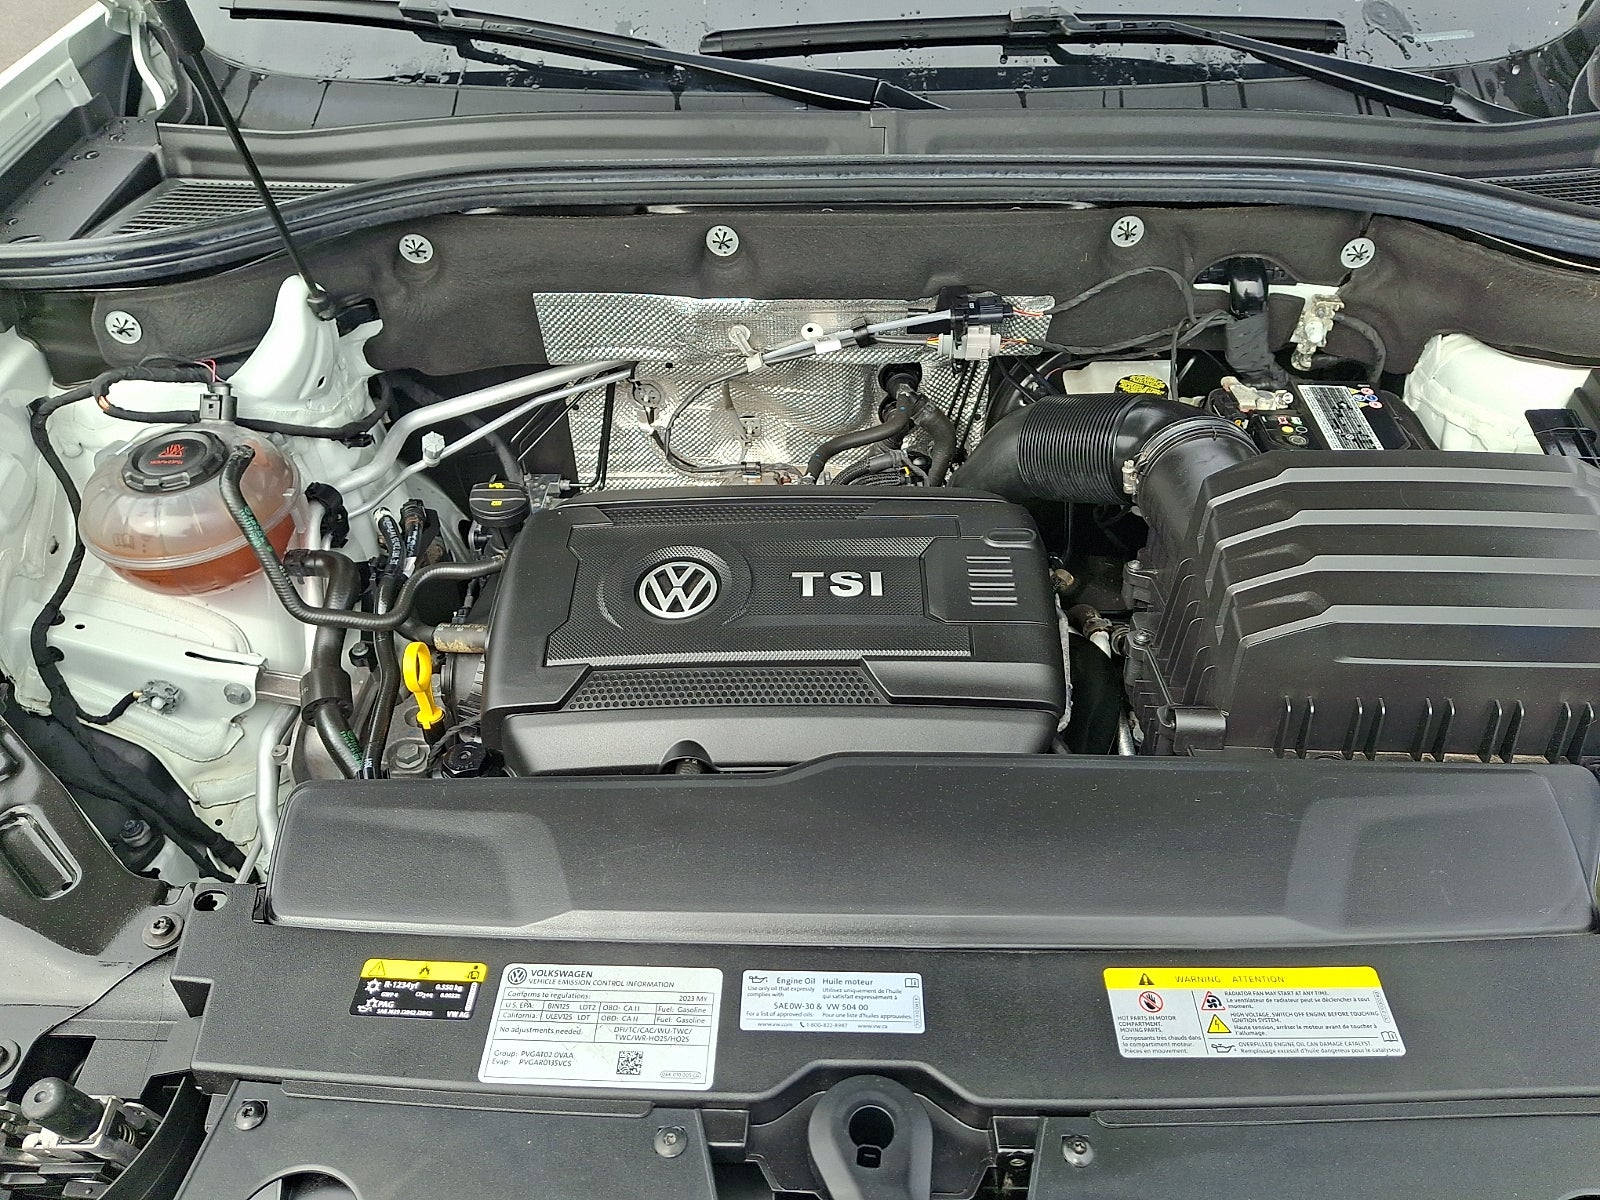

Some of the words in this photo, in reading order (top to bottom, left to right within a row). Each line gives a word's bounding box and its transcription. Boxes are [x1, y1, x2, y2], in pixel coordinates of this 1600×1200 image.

[791, 571, 883, 597] TSI
[531, 969, 593, 978] VOLKSWAGEN
[776, 976, 803, 986] Engine
[804, 977, 816, 985] Oil
[1174, 975, 1221, 983] WARNING
[1232, 975, 1285, 983] ATTENTION
[626, 980, 675, 988] INFORMATION
[551, 992, 591, 1000] regulations:
[378, 1000, 395, 1008] PAG
[677, 1006, 707, 1014] Gasoline
[502, 1011, 538, 1019] California:
[675, 1016, 706, 1024] Gasoline
[510, 1026, 554, 1035] adjustments
[493, 1049, 518, 1058] Group:
[491, 1058, 511, 1066] Evap:
